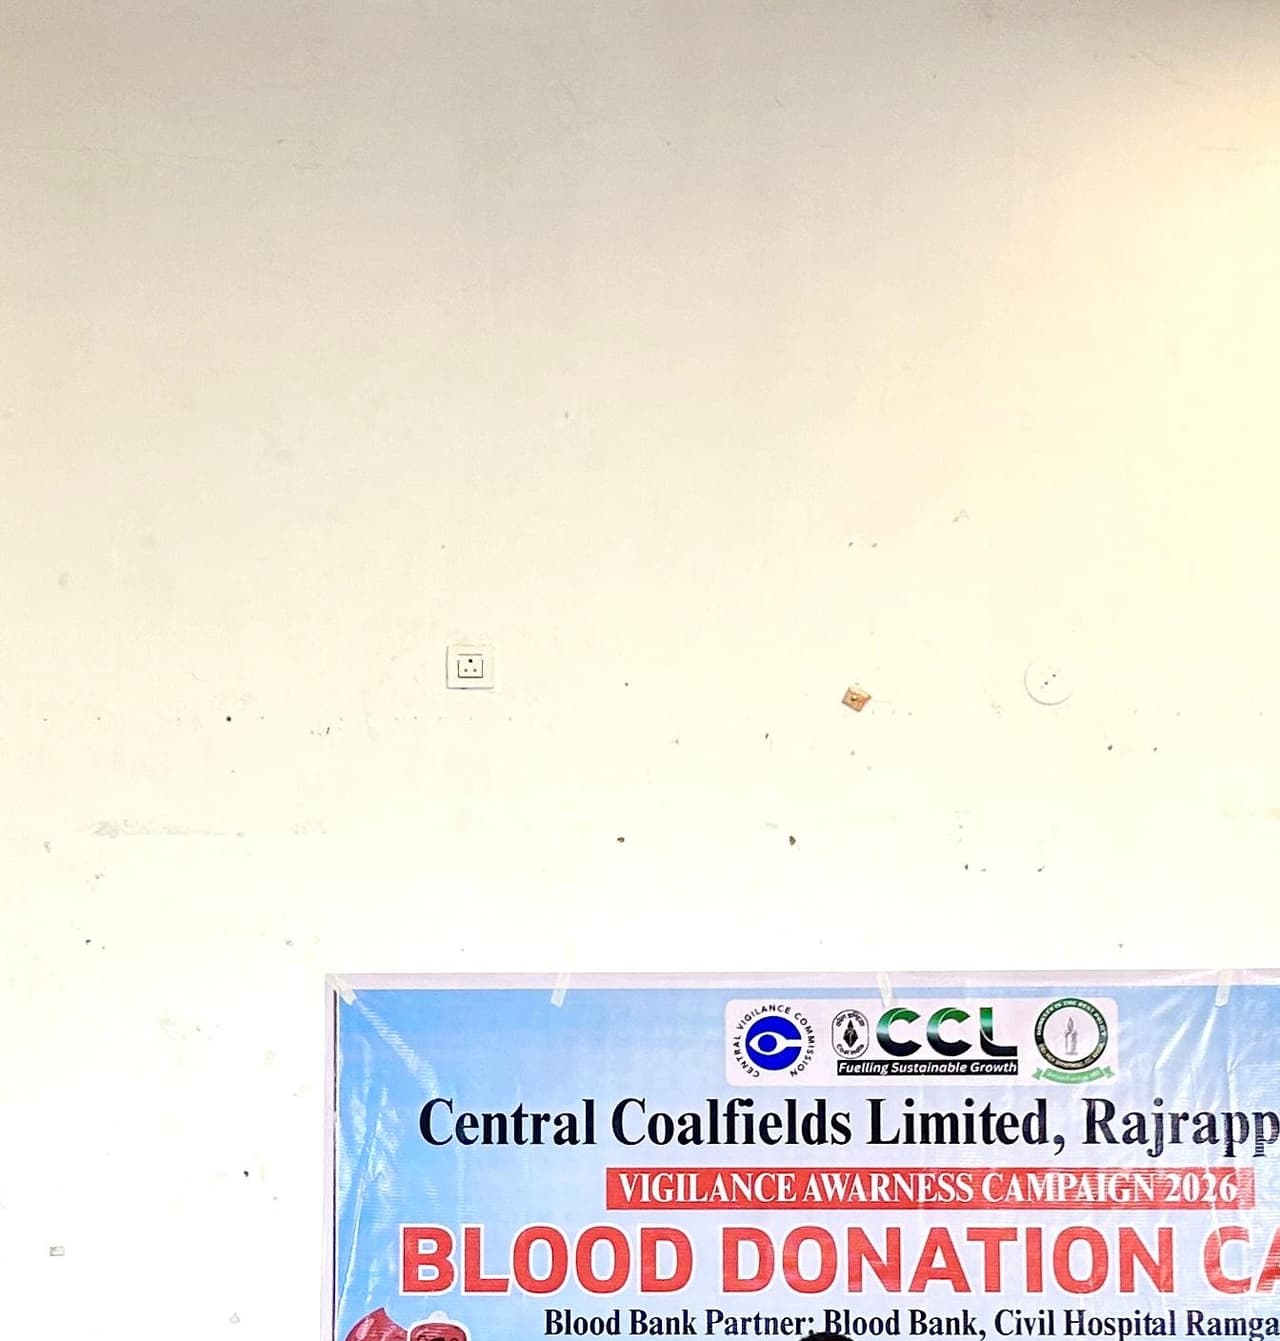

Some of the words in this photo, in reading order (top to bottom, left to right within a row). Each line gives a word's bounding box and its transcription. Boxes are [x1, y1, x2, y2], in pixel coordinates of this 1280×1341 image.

[736, 1004, 791, 1031] VIGILANCE
[876, 1007, 1017, 1057] CCL
[733, 1035, 760, 1078] CENTRAL
[790, 1012, 816, 1078] COMMISSION
[838, 1062, 888, 1076] Fuelling
[891, 1062, 967, 1074] Sustainable
[970, 1062, 1017, 1073] Growth
[420, 1097, 597, 1147] Central
[612, 1097, 851, 1147] Coalfields
[866, 1097, 1066, 1152] Limited,
[619, 1173, 795, 1203] VIGILANCE
[805, 1173, 974, 1203] AWARNESS
[981, 1173, 1155, 1203] CAMPAIGN
[1166, 1173, 1238, 1203] 2026
[401, 1226, 692, 1295] BLOOD
[723, 1226, 1174, 1295] DONATION
[544, 1309, 620, 1337] Blood
[629, 1309, 697, 1337] Bank
[705, 1309, 815, 1337] Partner:
[824, 1309, 900, 1336] Blood
[909, 1309, 987, 1341] Bank,
[995, 1309, 1056, 1337] Civil
